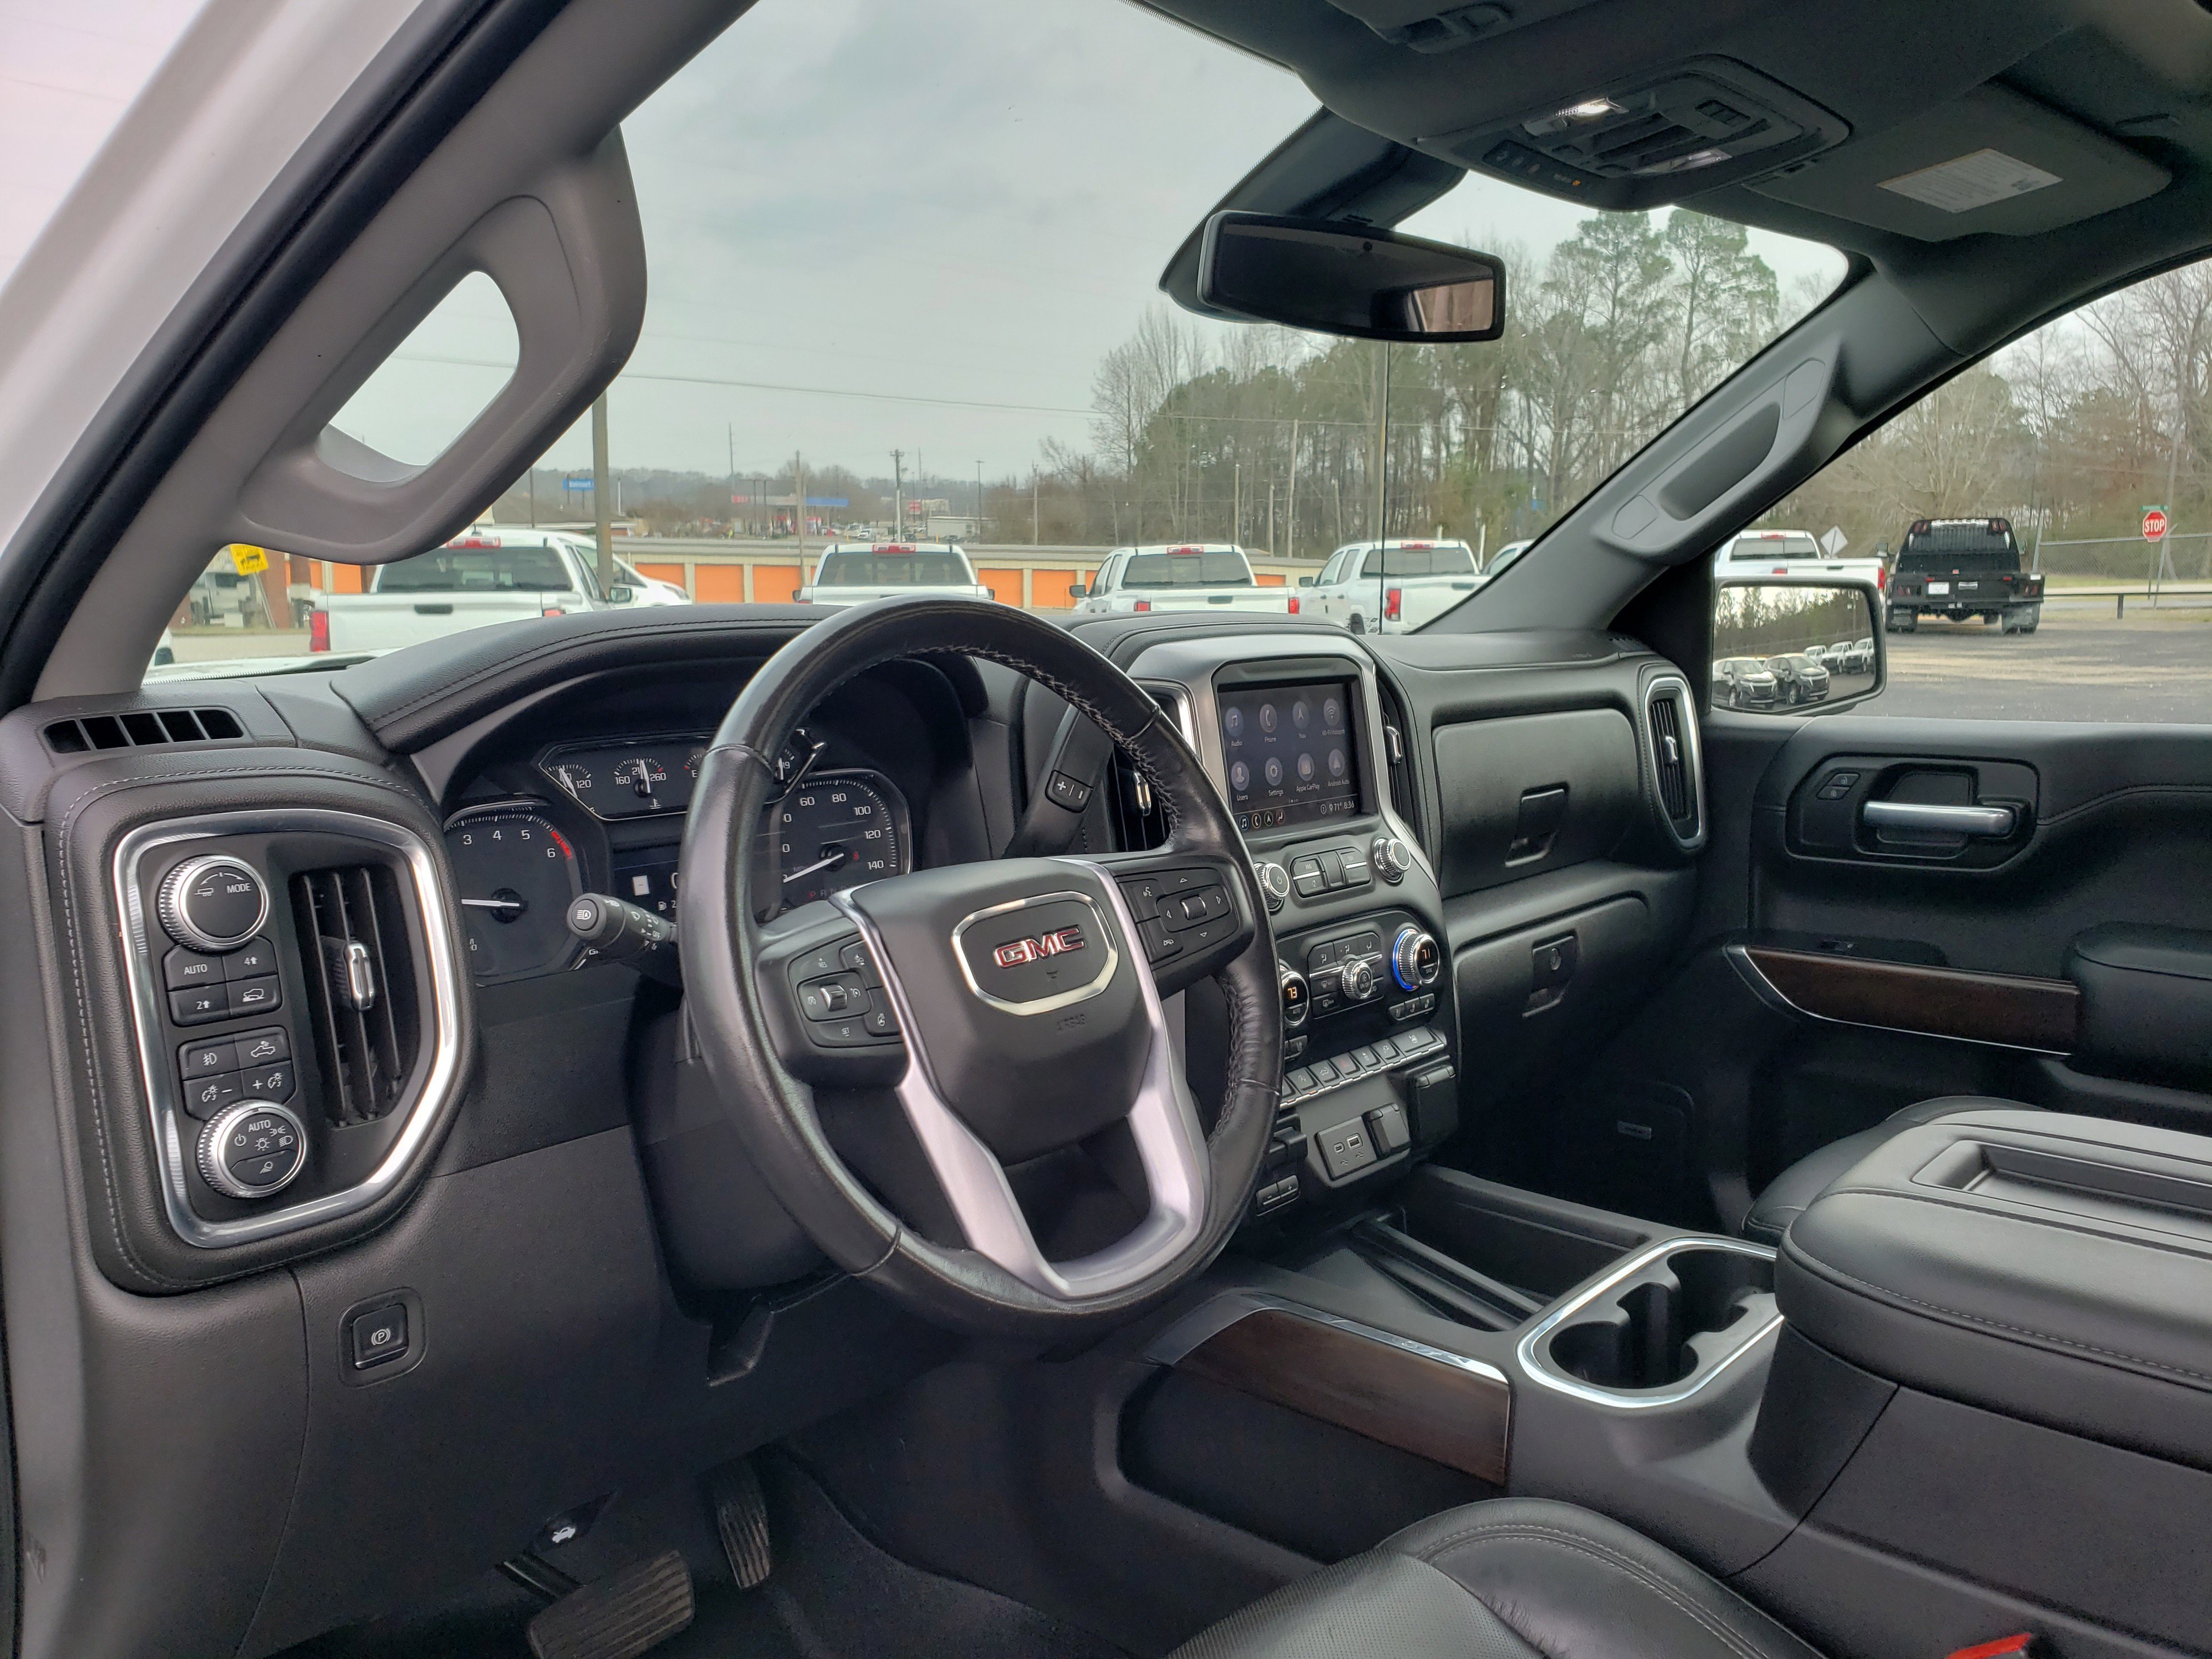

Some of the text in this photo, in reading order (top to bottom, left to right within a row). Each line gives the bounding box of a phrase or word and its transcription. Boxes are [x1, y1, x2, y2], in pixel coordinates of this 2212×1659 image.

[2145, 518, 2165, 532] STOP
[615, 776, 630, 785] 160
[650, 772, 667, 782] 260
[576, 779, 591, 789] 120
[799, 796, 815, 806] 60
[831, 792, 847, 803] 80
[854, 805, 872, 816] 100
[462, 834, 472, 845] 3
[493, 830, 502, 840] 4
[521, 829, 531, 840] 5
[864, 829, 881, 839] 120
[547, 848, 556, 858] 6
[867, 860, 884, 870] 140
[226, 882, 252, 894] MODE
[992, 927, 1085, 968] GMC
[184, 964, 208, 975] AUTO
[1287, 986, 1298, 1001] 73
[247, 1119, 272, 1133] AUTO
